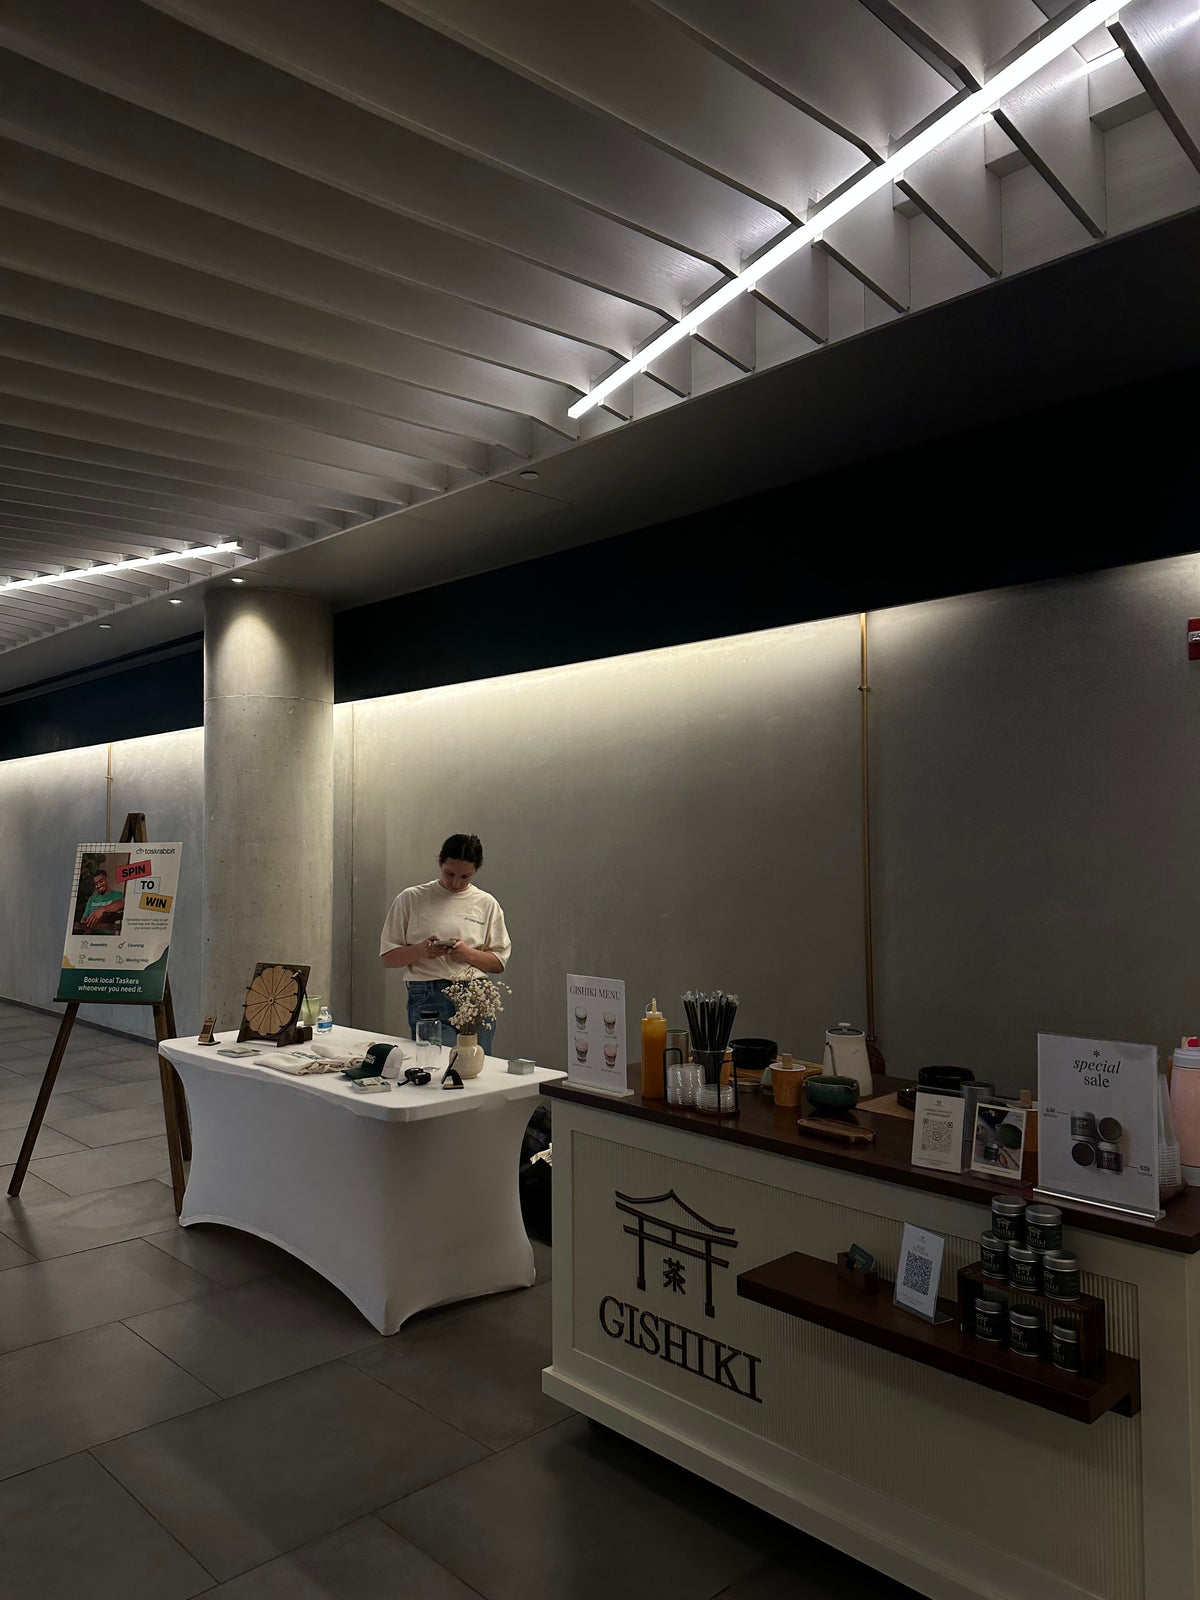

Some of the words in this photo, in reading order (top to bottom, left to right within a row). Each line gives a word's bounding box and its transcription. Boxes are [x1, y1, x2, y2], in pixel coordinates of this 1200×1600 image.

[121, 864, 146, 878] SPIN
[140, 880, 155, 890] TO
[145, 896, 168, 909] WIN
[99, 976, 114, 984] local
[115, 977, 139, 985] Taskers
[569, 985, 598, 998] GISHIKI
[598, 988, 621, 1000] MENU
[1073, 1058, 1121, 1074] special
[1083, 1074, 1110, 1088] sale
[662, 1257, 686, 1295] 茶
[599, 1295, 763, 1404] GISHIKI
